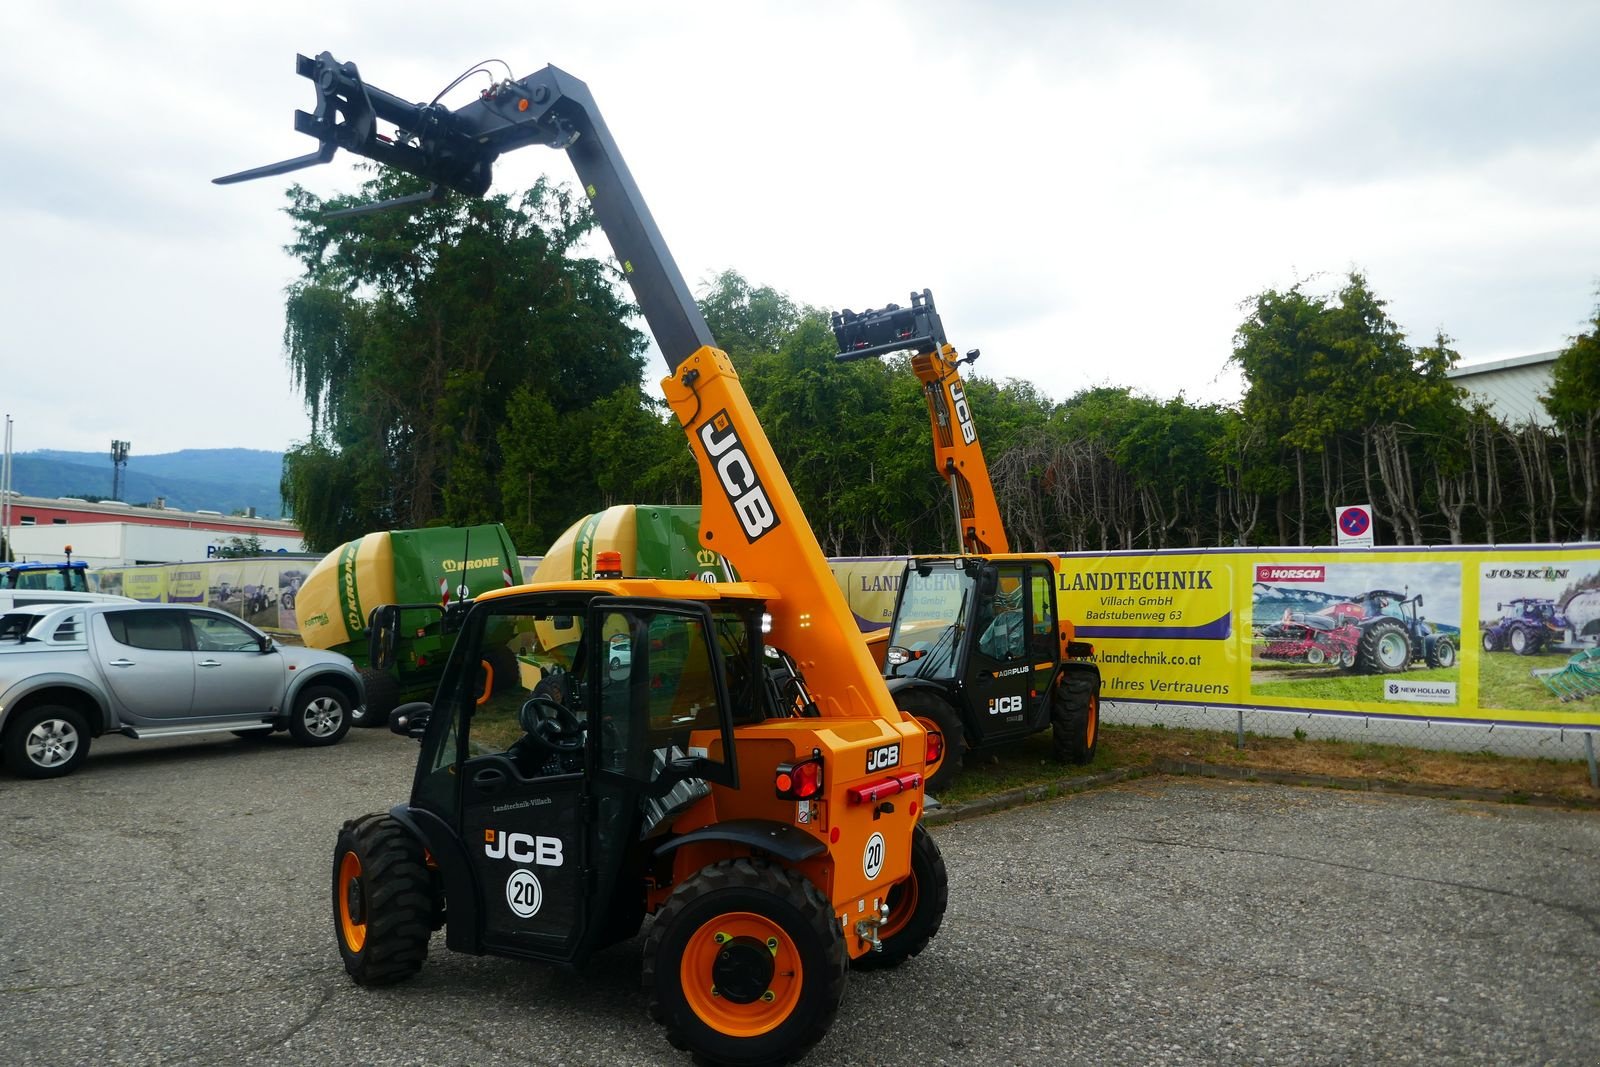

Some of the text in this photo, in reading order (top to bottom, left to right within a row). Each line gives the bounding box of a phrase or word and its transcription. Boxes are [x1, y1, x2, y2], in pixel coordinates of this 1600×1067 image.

[950, 383, 975, 444] JCB
[702, 421, 774, 538] JCB
[458, 557, 499, 571] KRONE
[1271, 569, 1320, 579] HORSCH
[1486, 568, 1570, 579] JOSKIN
[345, 546, 358, 613] KRONE
[1059, 571, 1214, 591] LANDTECHNIK
[1100, 597, 1174, 606] Villach GmbH
[1086, 611, 1182, 622] Badstubenweg 63
[1111, 678, 1145, 691] Ihres
[1150, 679, 1229, 695] Vertrauens
[1418, 687, 1450, 695] HOLLAND
[988, 695, 1022, 715] JCB
[867, 745, 899, 771] JCB
[493, 797, 552, 812] Landtechnik-Villach
[485, 830, 564, 867] JCB
[867, 843, 880, 870] 20
[514, 881, 535, 907] 20
